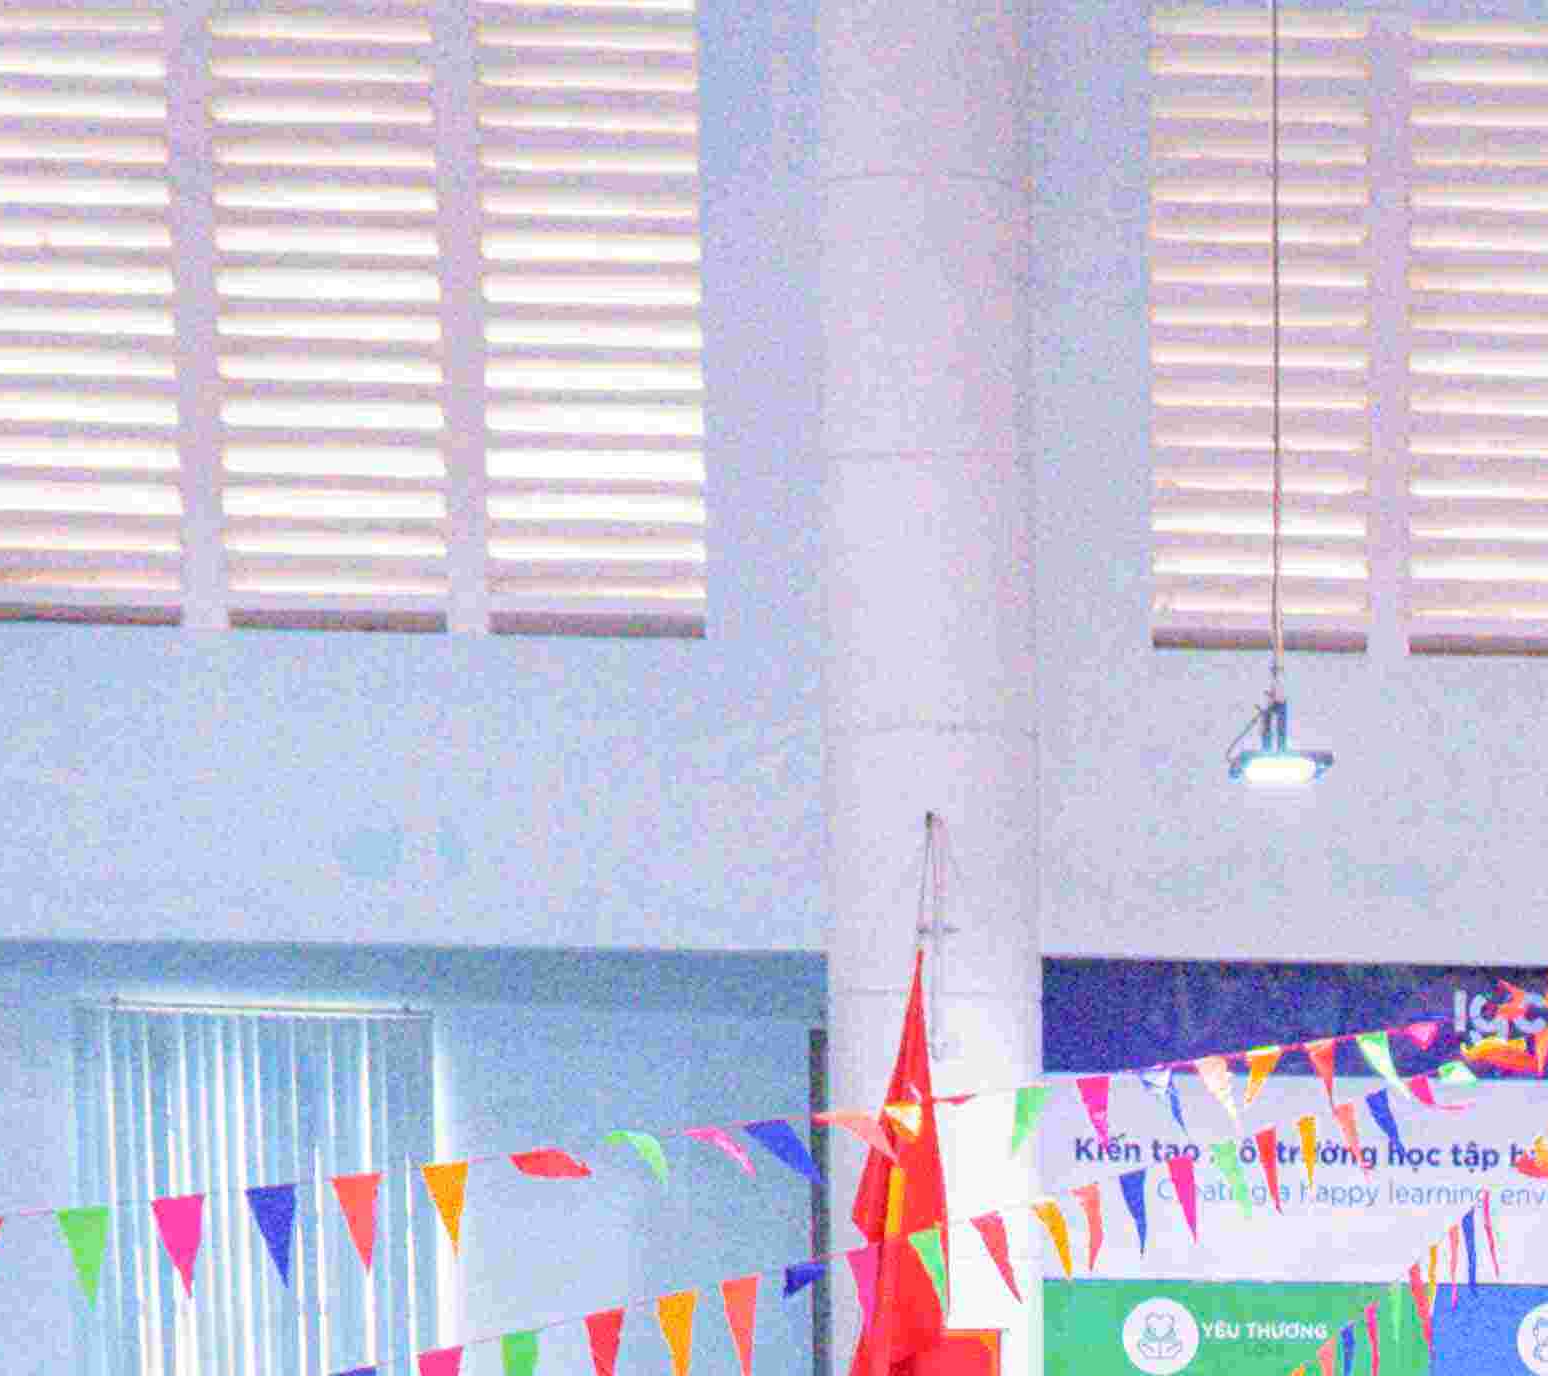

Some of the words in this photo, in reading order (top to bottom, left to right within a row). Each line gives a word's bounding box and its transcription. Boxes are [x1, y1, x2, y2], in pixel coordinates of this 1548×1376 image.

[1075, 1133, 1142, 1163] Kiến
[1388, 1138, 1442, 1174] học
[1451, 1141, 1500, 1174] tập
[1389, 1179, 1491, 1208] learning
[1202, 1319, 1242, 1341] YÊU
